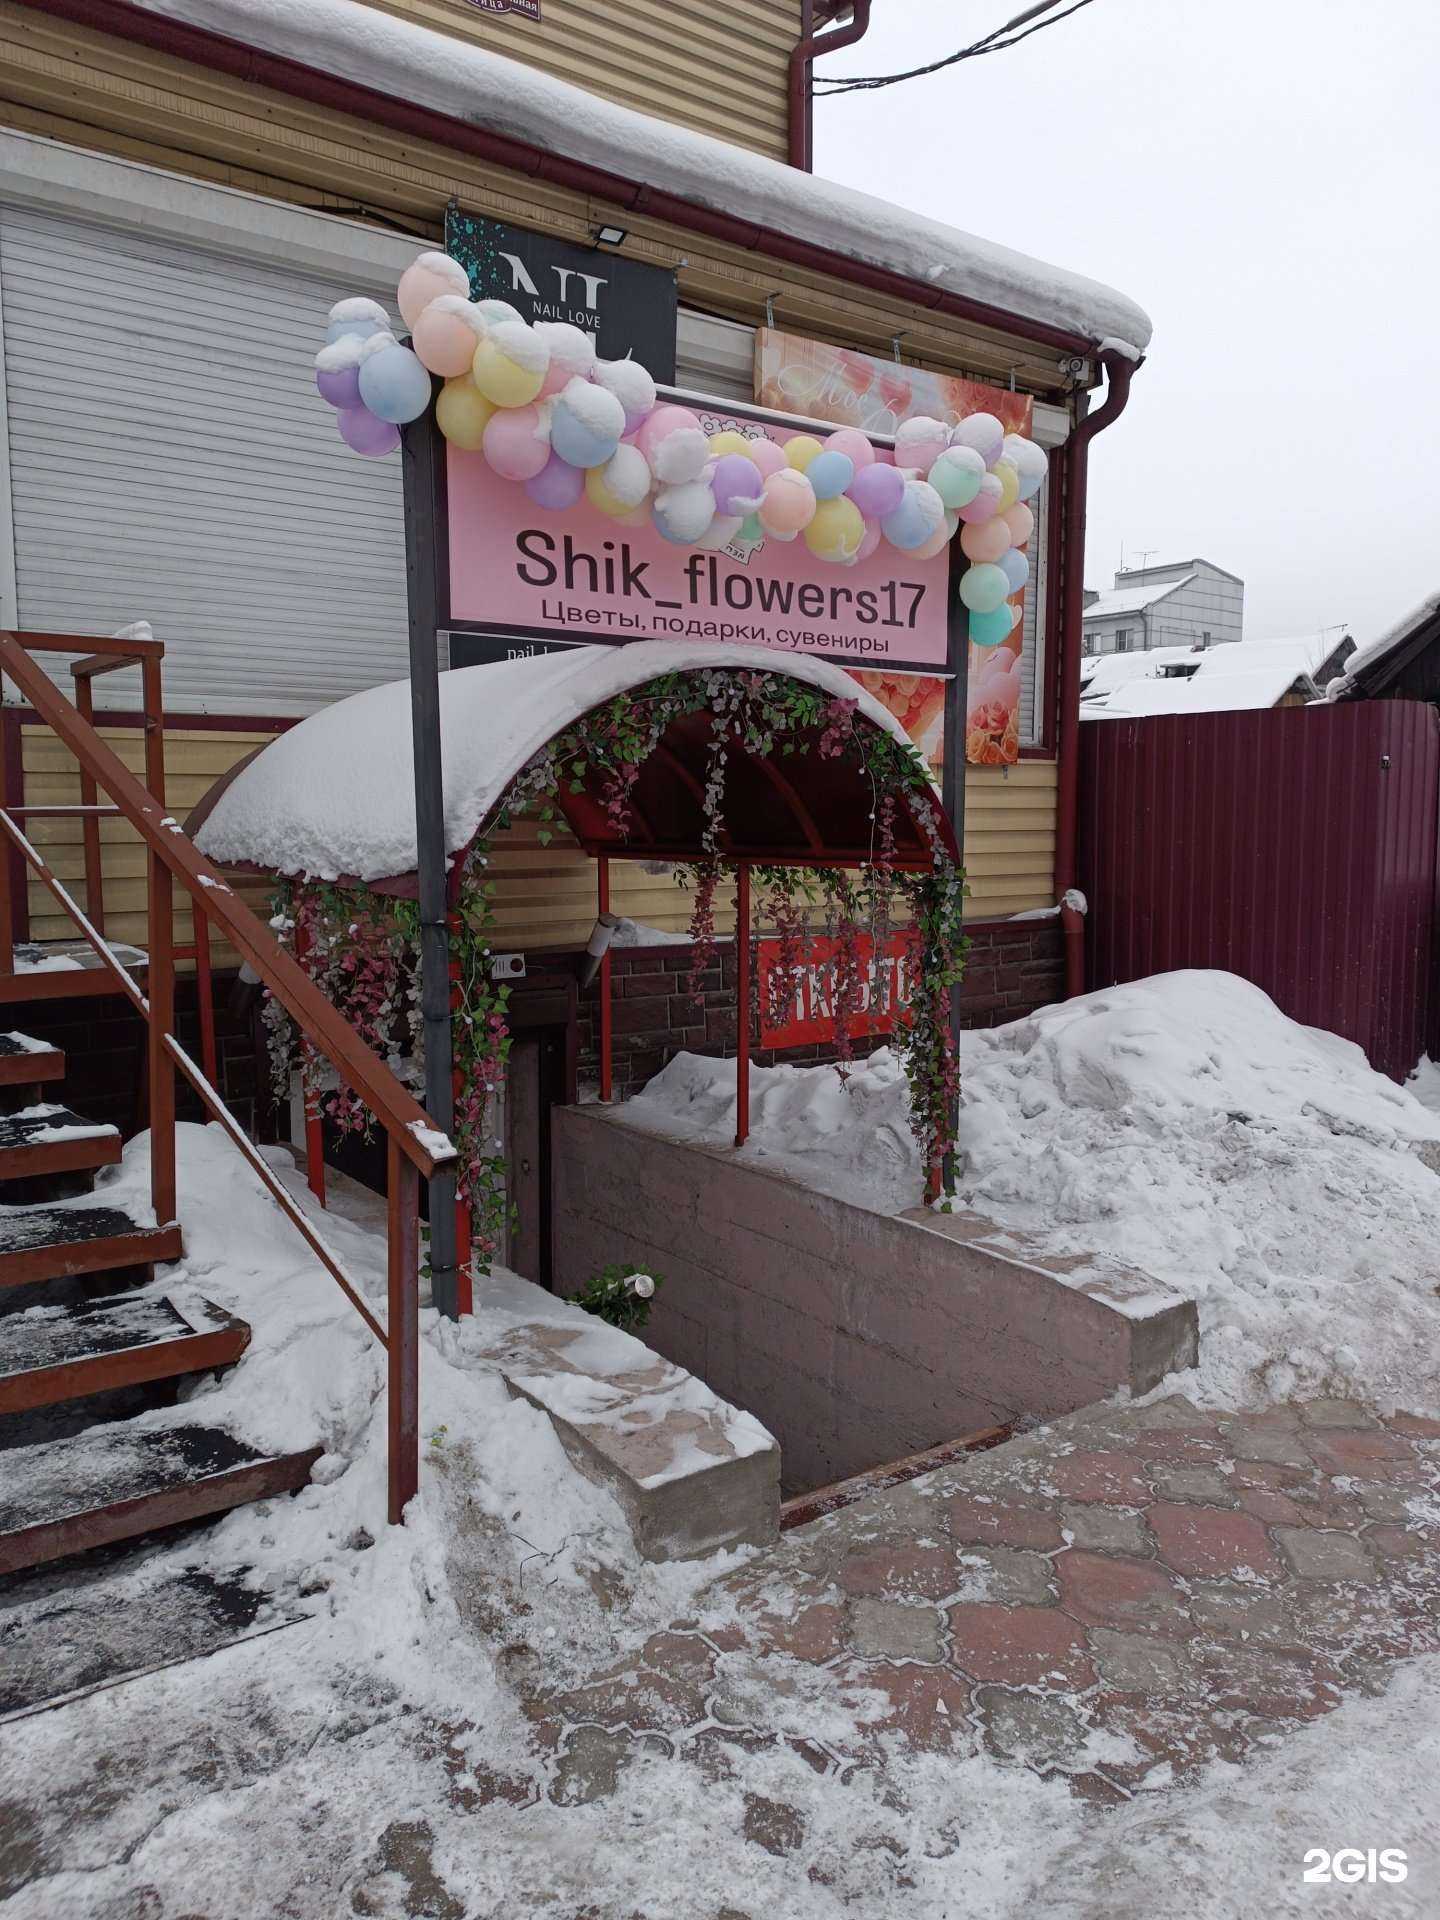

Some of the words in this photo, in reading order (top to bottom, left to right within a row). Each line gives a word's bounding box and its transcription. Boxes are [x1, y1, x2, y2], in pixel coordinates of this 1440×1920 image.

[533, 301, 564, 321] NAIL
[568, 309, 601, 329] LOVE
[515, 528, 927, 629] Shik_flowers17
[541, 599, 647, 631] Цветы,
[653, 615, 772, 644] подарки,
[776, 627, 889, 653] сувениры
